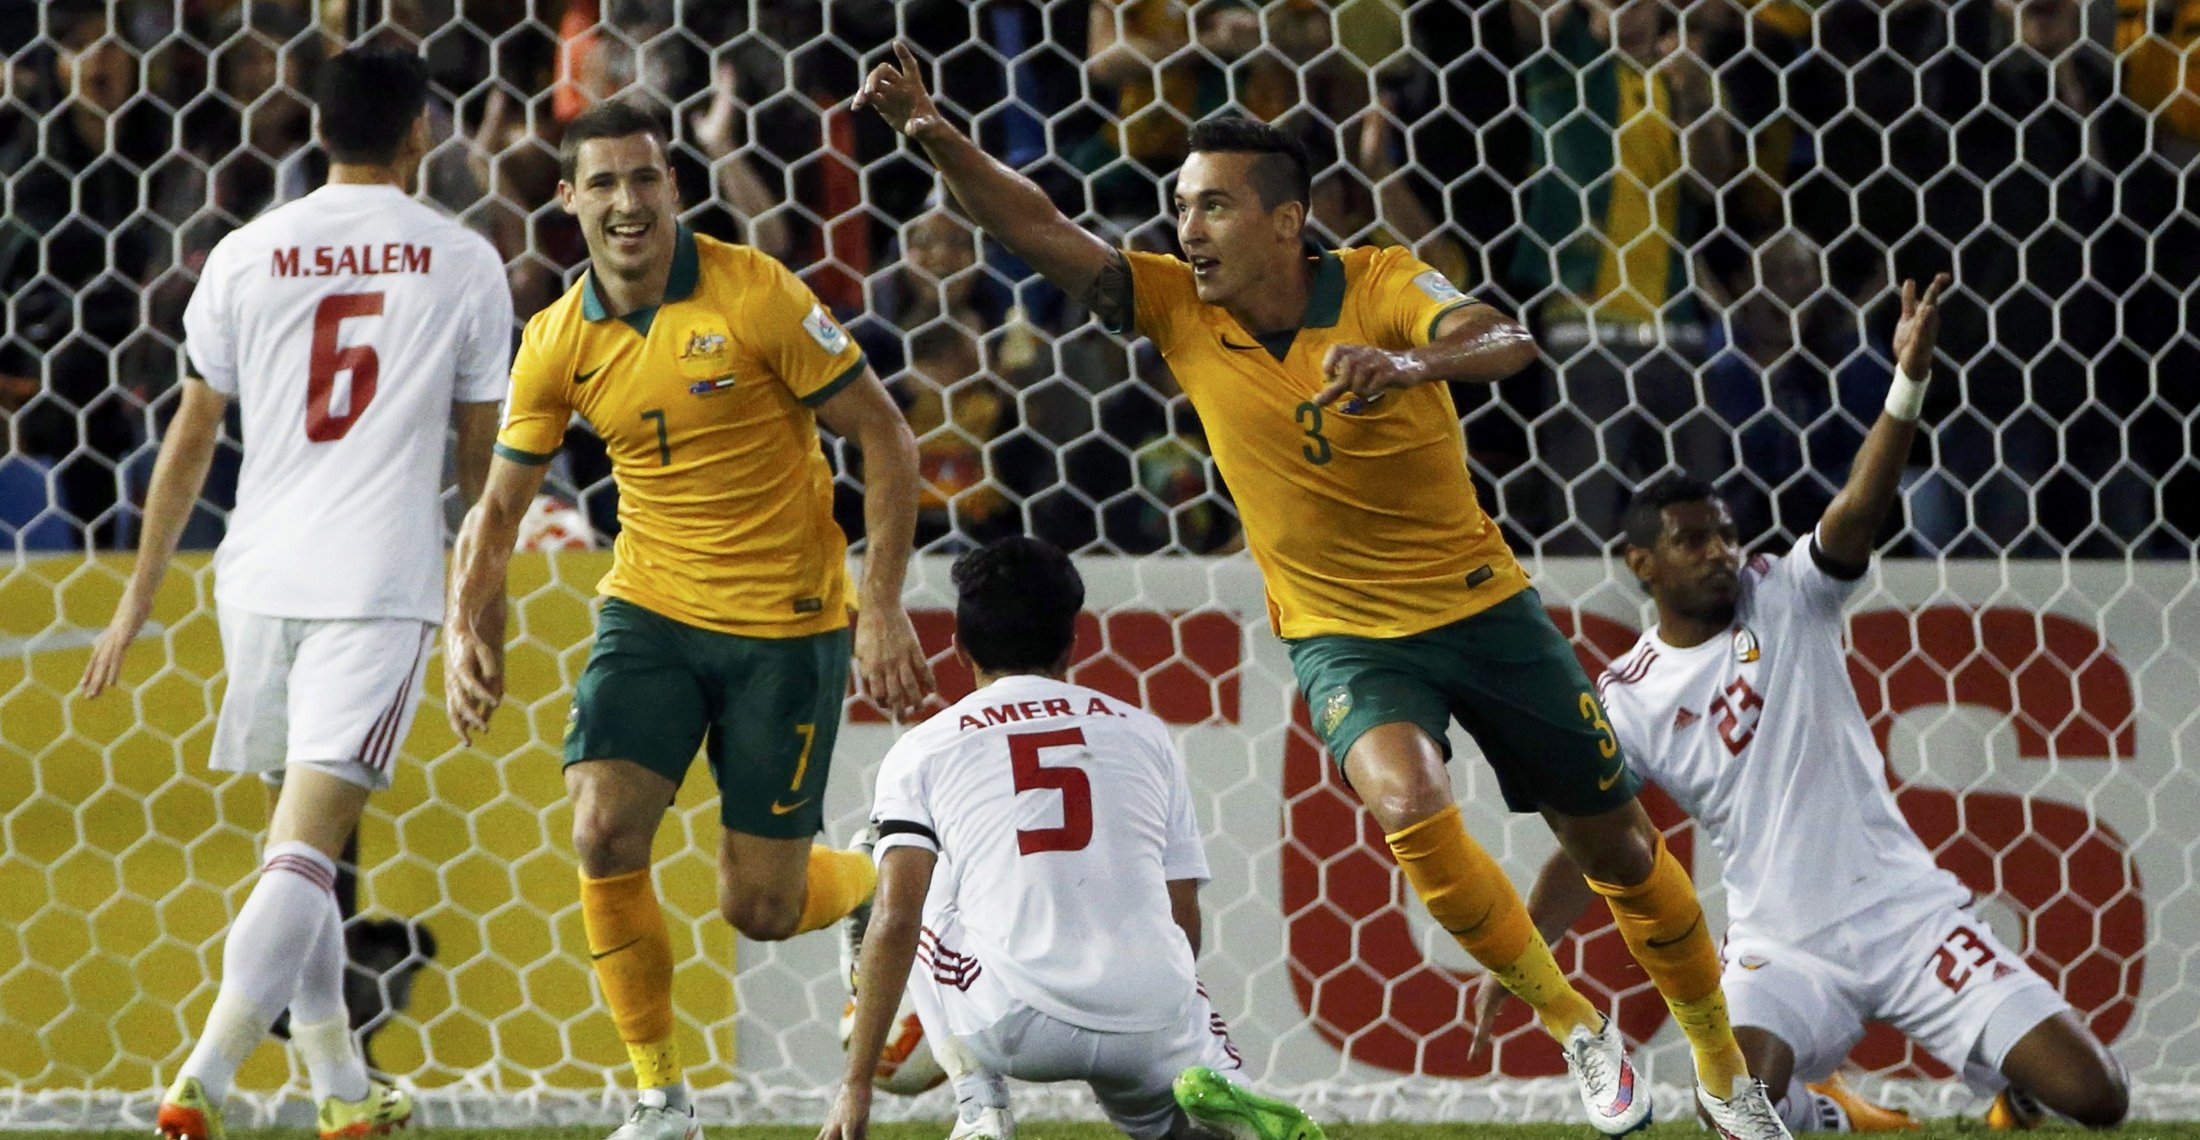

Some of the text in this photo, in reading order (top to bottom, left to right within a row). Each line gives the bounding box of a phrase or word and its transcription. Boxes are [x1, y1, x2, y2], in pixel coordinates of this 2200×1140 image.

[271, 243, 432, 278] M.SALEM
[305, 291, 385, 443] 6
[641, 409, 671, 467] 7
[1295, 400, 1332, 467] 3
[959, 697, 1127, 731] AMER A.
[1579, 692, 1617, 759] 3
[1709, 675, 1764, 757] 23
[790, 723, 816, 791] 7
[1007, 726, 1094, 856] 5
[1923, 925, 1996, 994] 23
